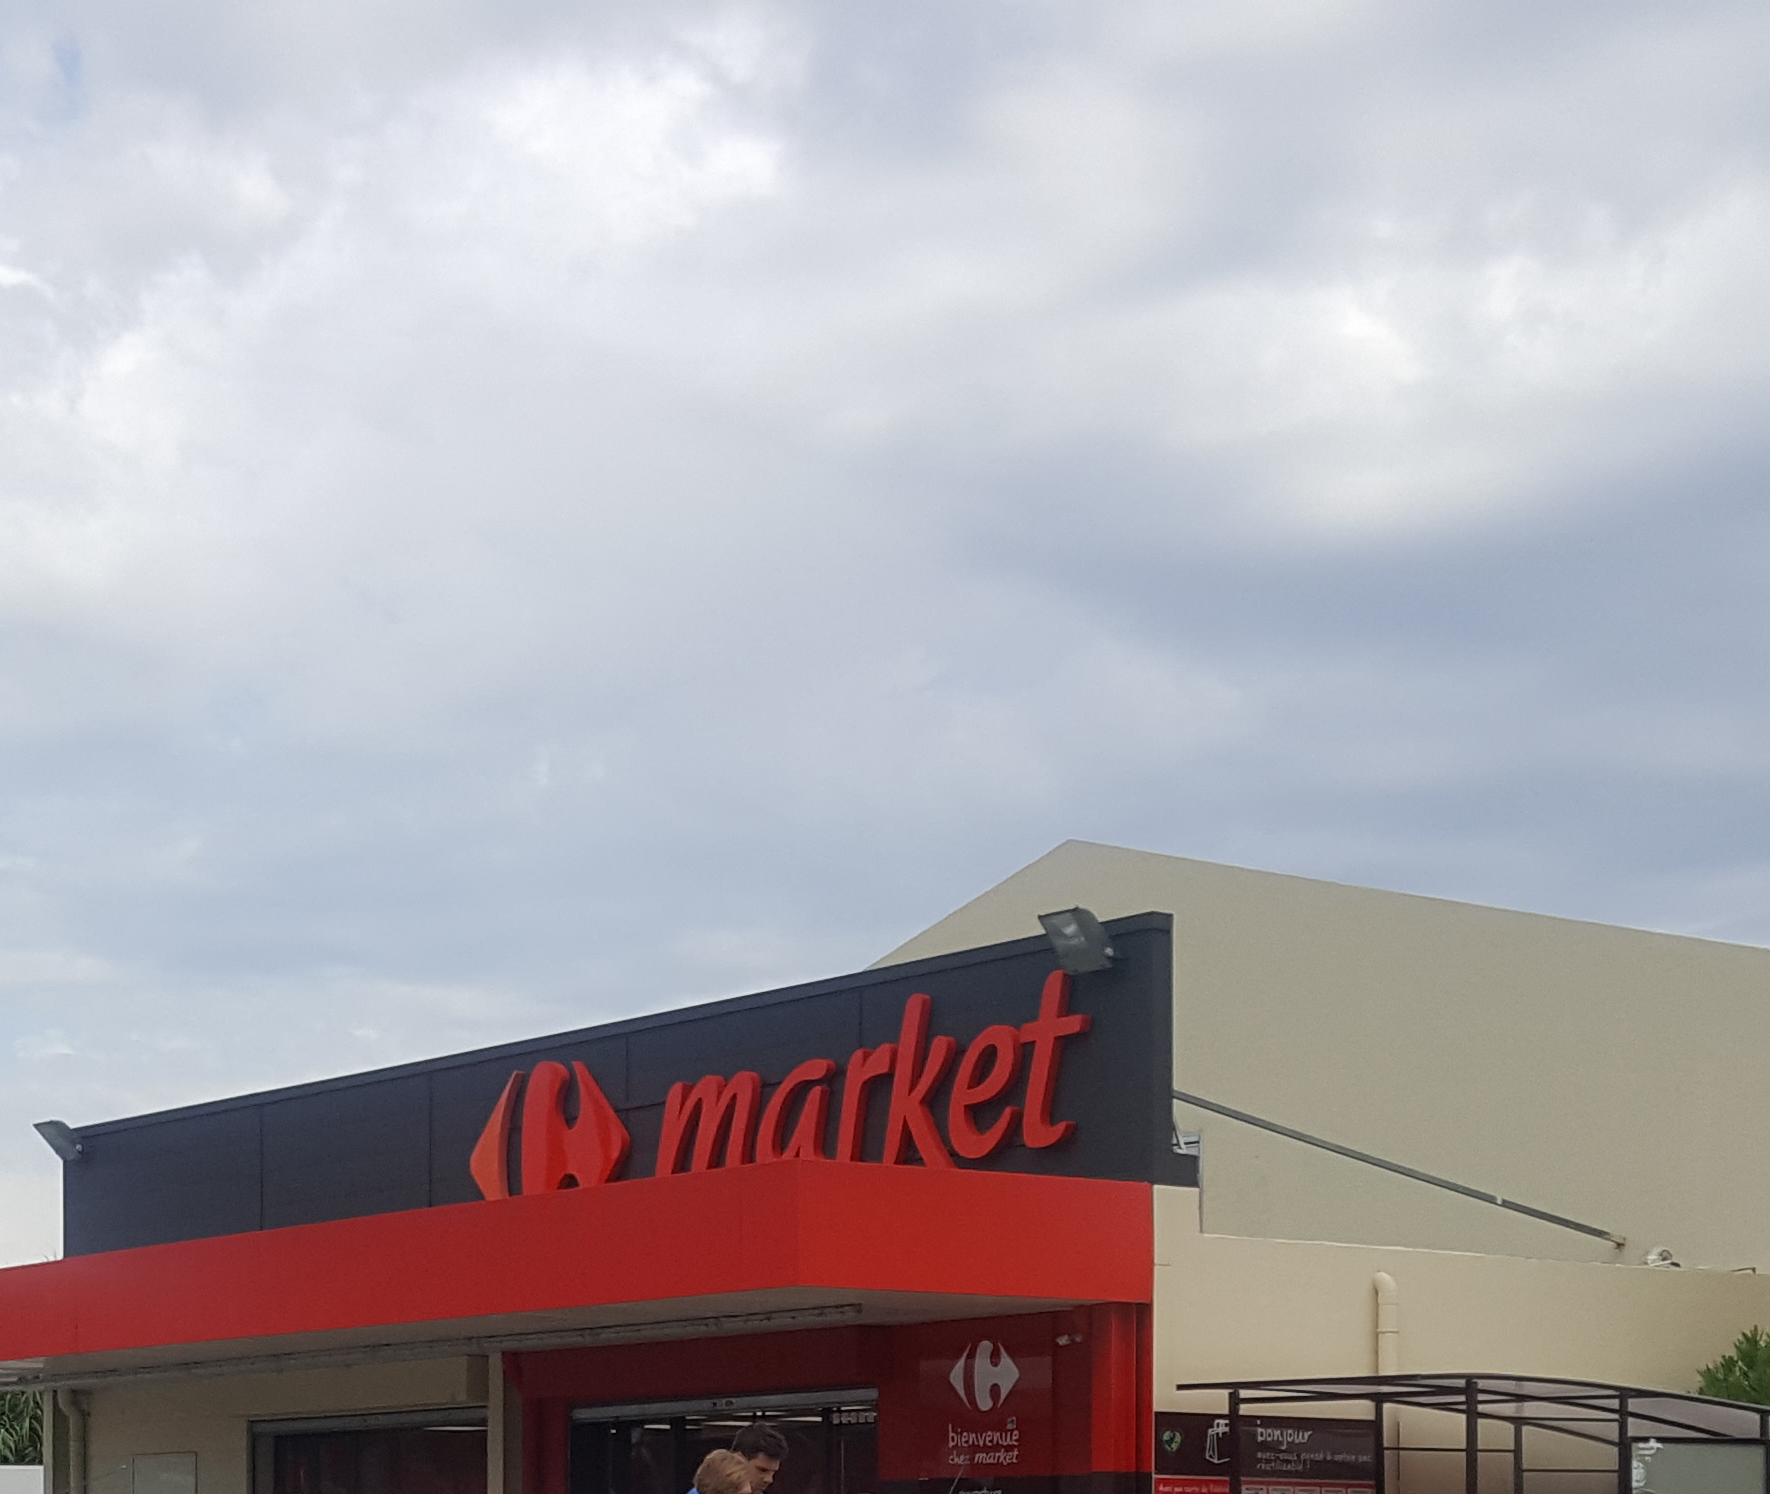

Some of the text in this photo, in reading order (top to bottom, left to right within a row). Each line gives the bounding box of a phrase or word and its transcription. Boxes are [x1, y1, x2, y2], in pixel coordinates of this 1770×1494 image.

[655, 969, 1092, 1176] market
[948, 1423, 1020, 1448] bienvenue
[1256, 1420, 1314, 1450] bonjour
[948, 1448, 1019, 1466] chez market
